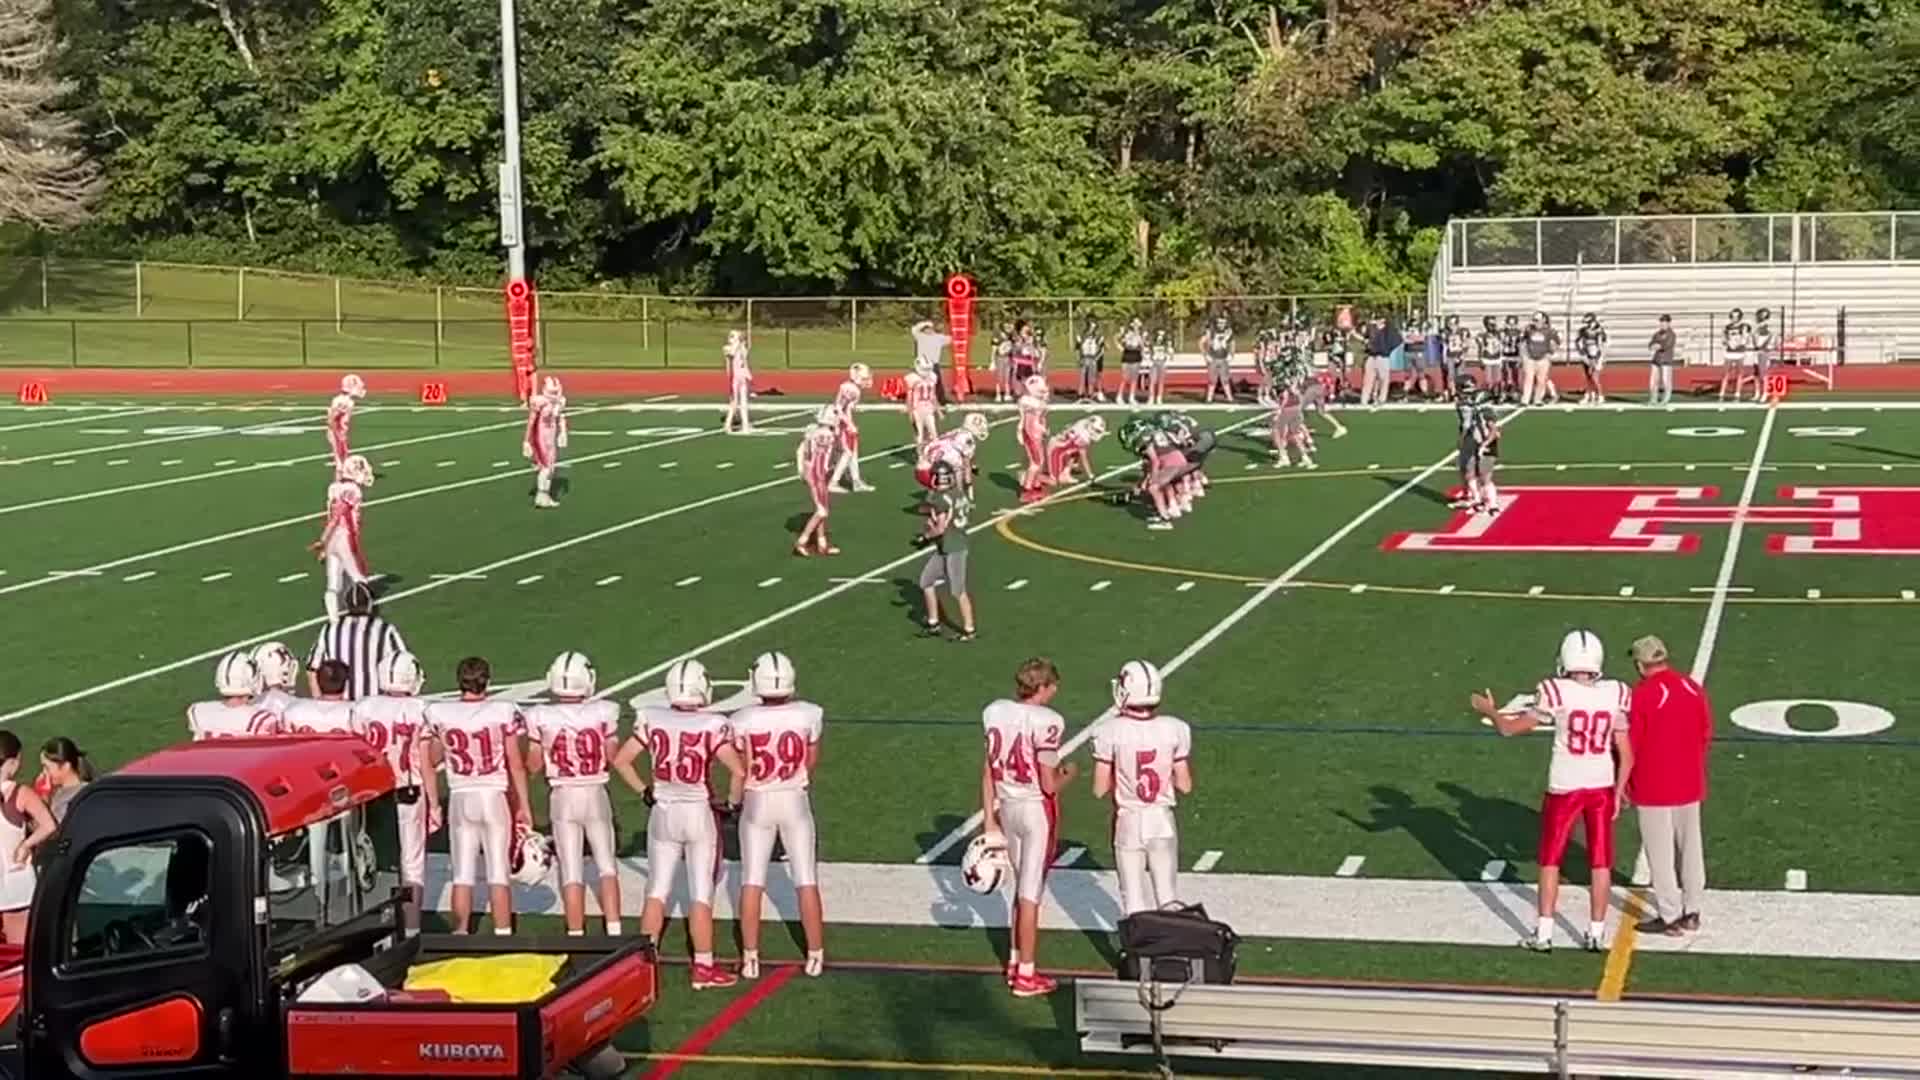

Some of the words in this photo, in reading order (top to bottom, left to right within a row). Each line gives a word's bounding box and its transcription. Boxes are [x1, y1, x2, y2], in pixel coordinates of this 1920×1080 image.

[425, 385, 440, 400] 20
[1767, 376, 1783, 393] 50
[445, 727, 499, 776] 31
[550, 728, 602, 777] 49
[651, 728, 704, 784] 25
[749, 729, 806, 783] 59
[986, 726, 1032, 784] 24
[1567, 709, 1612, 756] 80
[1135, 748, 1161, 803] 5
[418, 1042, 506, 1062] KUBOTA
